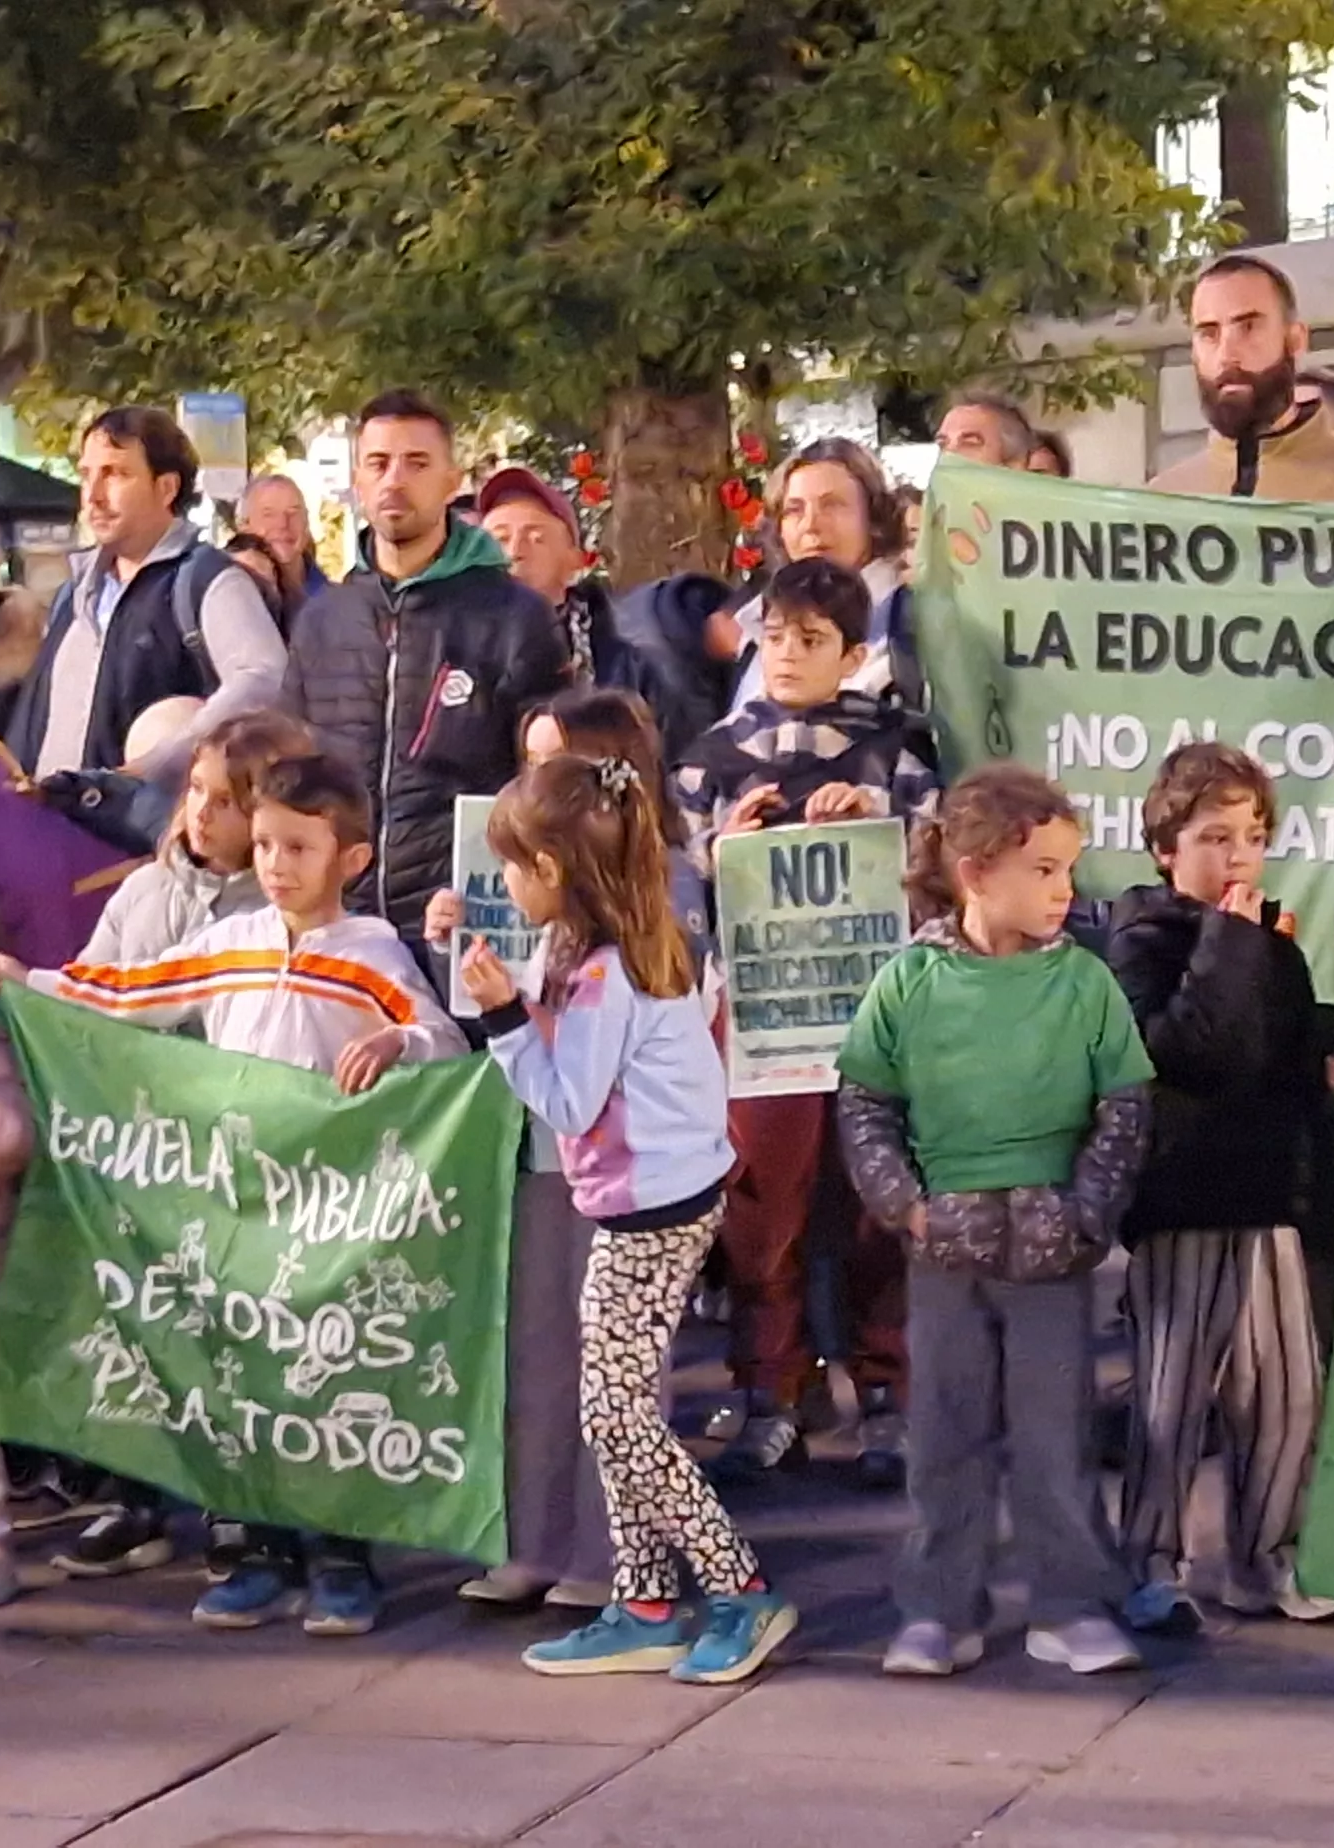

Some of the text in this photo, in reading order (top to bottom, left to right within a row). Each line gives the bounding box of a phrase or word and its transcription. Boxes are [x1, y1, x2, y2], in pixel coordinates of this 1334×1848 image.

[1001, 519, 1238, 584] DINERO
[1002, 608, 1076, 671] LA
[1046, 712, 1149, 782] ¡NO
[768, 841, 851, 909] NO!
[49, 1102, 463, 1243] ESCUELA PÚBLICA:
[93, 1259, 176, 1322] DE
